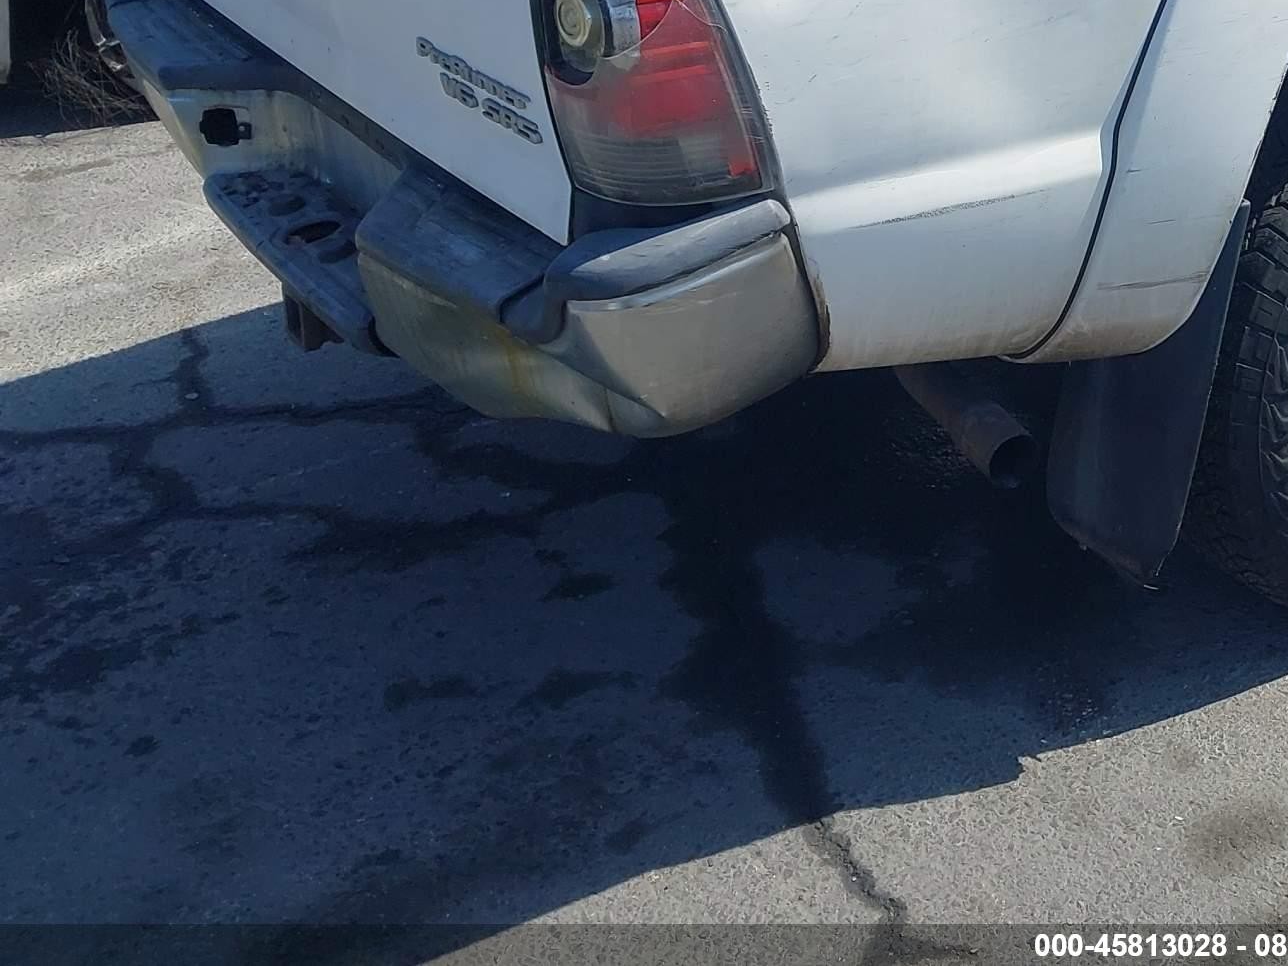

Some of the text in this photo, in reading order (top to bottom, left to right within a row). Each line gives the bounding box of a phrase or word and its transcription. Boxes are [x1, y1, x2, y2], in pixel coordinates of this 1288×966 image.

[415, 36, 532, 110] PreRunner
[439, 72, 544, 145] V6 SR5
